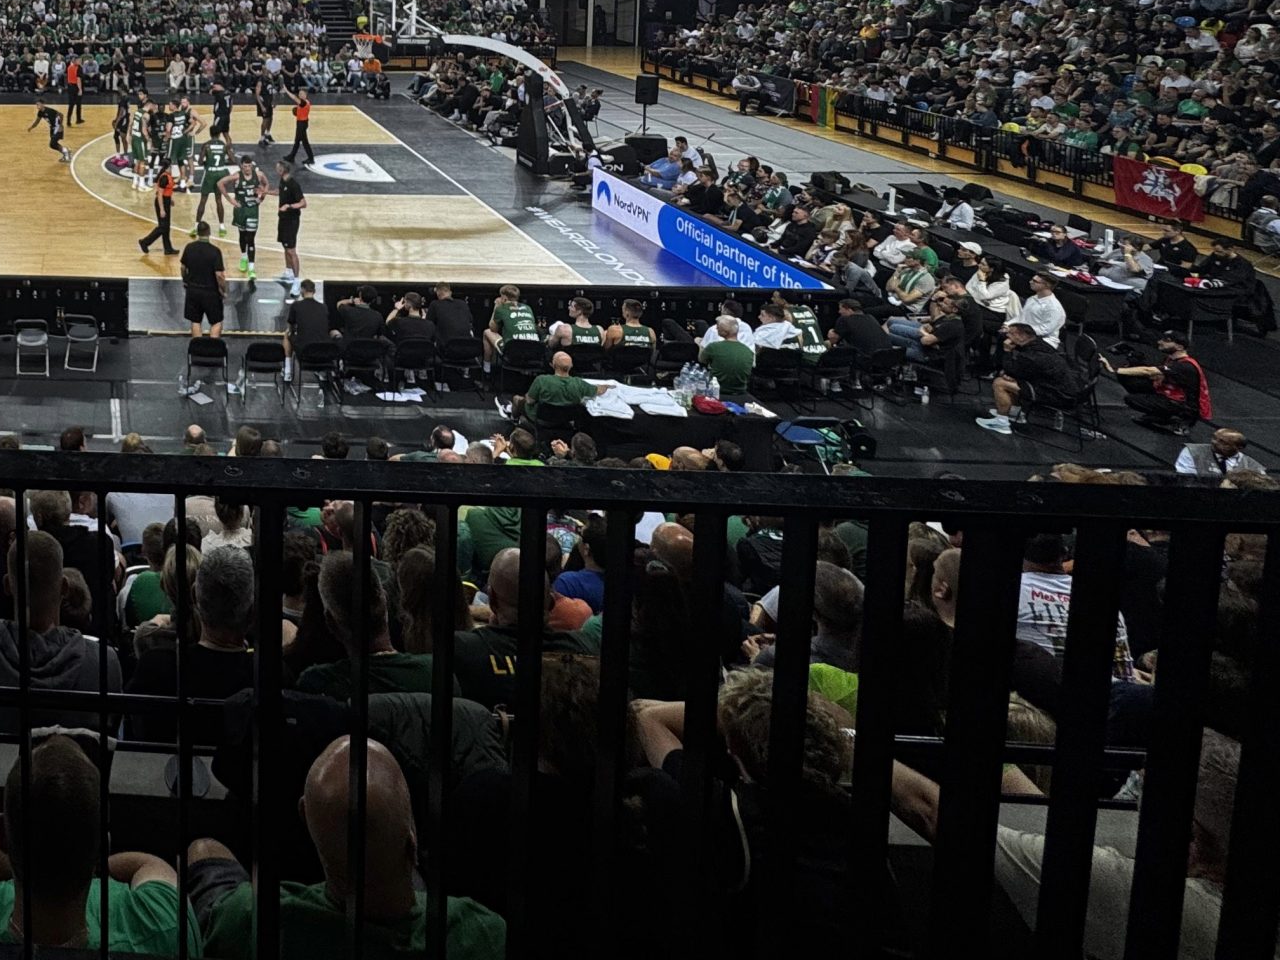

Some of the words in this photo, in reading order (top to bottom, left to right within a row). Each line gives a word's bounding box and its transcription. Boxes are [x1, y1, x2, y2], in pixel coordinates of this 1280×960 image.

[613, 193, 650, 223] NordVPN
[676, 216, 714, 248] Official
[716, 242, 761, 274] partner
[763, 265, 778, 282] of
[780, 271, 803, 288] the
[695, 247, 737, 284] London
[740, 271, 762, 288] Lio
[807, 326, 820, 343] 1
